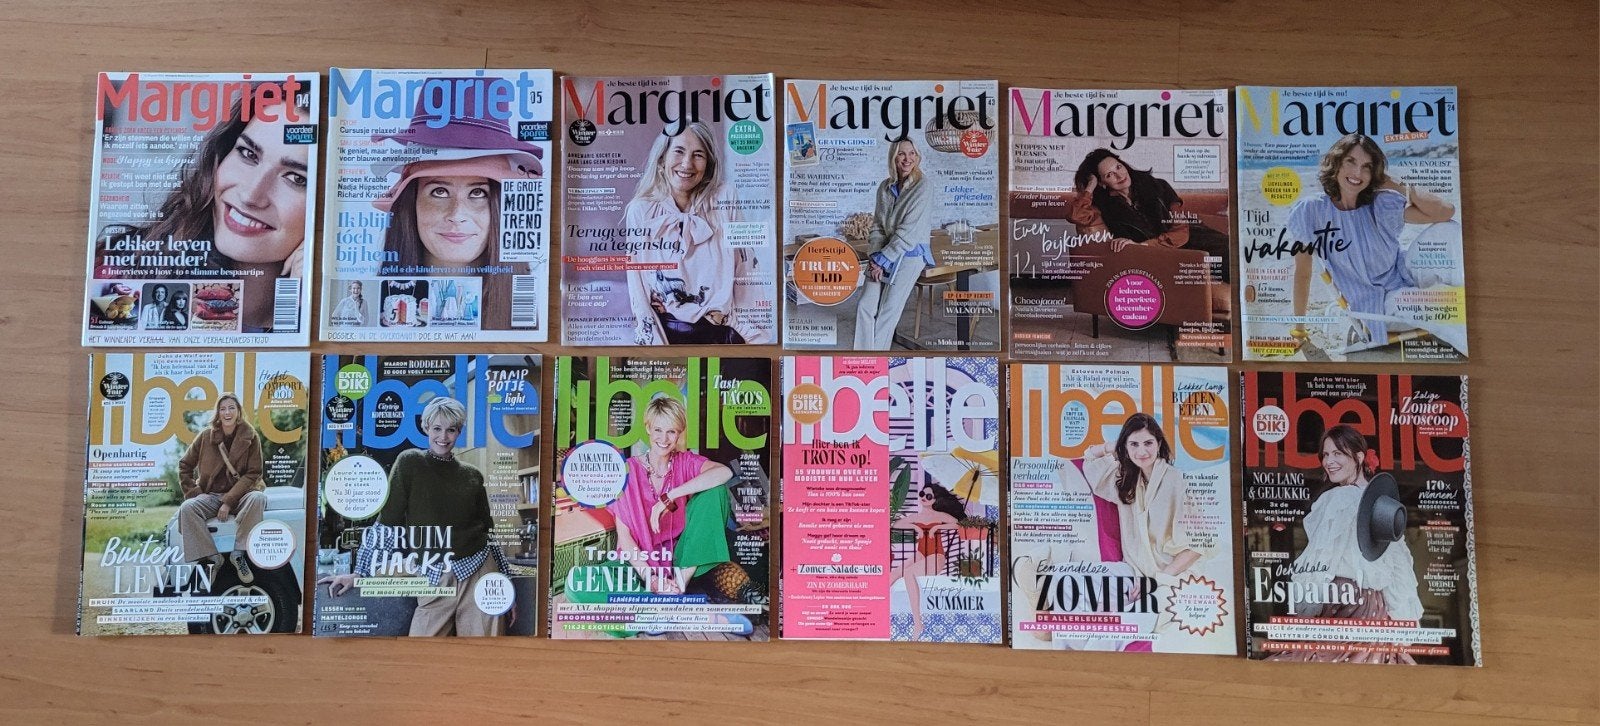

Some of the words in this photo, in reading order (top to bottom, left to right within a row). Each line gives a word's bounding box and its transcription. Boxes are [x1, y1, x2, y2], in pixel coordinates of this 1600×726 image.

[98, 73, 301, 132] Margriet
[329, 69, 534, 129] Margriet
[530, 92, 543, 104] 05
[565, 77, 771, 136] Margriet
[787, 83, 994, 143] Margriet
[1012, 89, 1224, 150] Margriet
[520, 123, 548, 131] voordeel
[1385, 134, 1410, 142] EXTRA
[338, 183, 357, 191] Nadja
[504, 183, 514, 192] DE
[516, 182, 542, 191] GROTE
[504, 194, 543, 210] MODE
[954, 194, 993, 202] griezelen
[1169, 211, 1198, 219] Mokka
[1244, 210, 1270, 225] Tijd
[338, 212, 355, 228] Ik
[359, 212, 394, 232] blijf
[504, 214, 541, 229] TREND
[567, 224, 651, 244] Terugveren
[1013, 216, 1050, 241] Even
[1247, 228, 1275, 237] voor
[336, 230, 372, 244] tóch
[503, 231, 541, 250] GIDS!
[1245, 221, 1352, 263] vakantie
[105, 236, 164, 251] Lekker
[168, 237, 211, 251] leven
[589, 241, 607, 252] na
[1042, 230, 1114, 260] bijkomen
[336, 246, 356, 265] bij
[362, 247, 399, 262] hem
[808, 246, 845, 254] Herfsttijd
[103, 253, 137, 266] met
[141, 251, 208, 267] minder!
[800, 261, 854, 272] TRUIEN-
[811, 273, 842, 283] TIJD
[568, 284, 587, 292] Loes
[589, 284, 611, 292] Luca
[1424, 305, 1458, 313] bewegen
[1425, 314, 1433, 322] je
[409, 360, 450, 368] RODDELEN
[260, 370, 288, 382] Herfst
[484, 369, 529, 381] STAMP
[258, 381, 303, 390] COMFORT
[338, 378, 369, 389] DIK!
[489, 381, 525, 392] POTJE
[713, 375, 742, 390] Tasty
[1178, 382, 1204, 391] Lekker
[1205, 383, 1224, 395] lang
[90, 352, 308, 445] libelle
[268, 390, 292, 399] FOOD
[504, 393, 525, 406] light
[721, 390, 764, 405] TACO'S
[1171, 392, 1215, 404] BUITEN
[1413, 390, 1440, 401] Zalige
[783, 357, 999, 453] libelle
[793, 401, 823, 410] DIK!
[1179, 404, 1209, 416] ETEN
[1400, 397, 1447, 414] Zomer
[1010, 365, 1229, 462] libelle
[1245, 372, 1468, 472] libelle
[1256, 421, 1286, 432] DIK!
[1390, 412, 1459, 431] horoscoop
[812, 439, 831, 449] Hier
[832, 439, 848, 449] ben
[850, 439, 860, 449] ik
[93, 449, 147, 460] Openhartig
[578, 453, 613, 463] VAKANTIE
[801, 450, 846, 465] TROTS
[851, 451, 871, 468] op!
[570, 463, 579, 471] IN
[580, 463, 602, 471] EIGEN
[604, 463, 620, 471] TUIN
[1013, 459, 1065, 471] Persoonlijke
[1013, 471, 1050, 481] verhalen
[1253, 473, 1275, 485] NOG
[1277, 474, 1304, 485] LANG
[737, 488, 762, 496] TWEEDE
[1249, 490, 1256, 501] &
[1258, 487, 1310, 499] GELUKKIG
[1418, 489, 1458, 499] winnen!
[362, 526, 453, 550] OPRUIM
[101, 535, 184, 567] Buiten
[586, 547, 673, 562] Tropisch
[370, 550, 455, 577] HACKS
[1037, 559, 1056, 573] Een
[1059, 561, 1109, 573] eindeloze
[112, 564, 215, 594] LEVEN
[485, 580, 504, 588] FACE
[567, 566, 690, 593] GENIETEN
[484, 588, 504, 596] YOGA
[922, 579, 965, 597] Happy
[1036, 575, 1161, 614] ZOMER
[926, 596, 984, 611] SUMMER
[1051, 615, 1120, 623] ALLERLEUKSTE
[1023, 624, 1138, 632] NAZOMERDORPSFEESTEN
